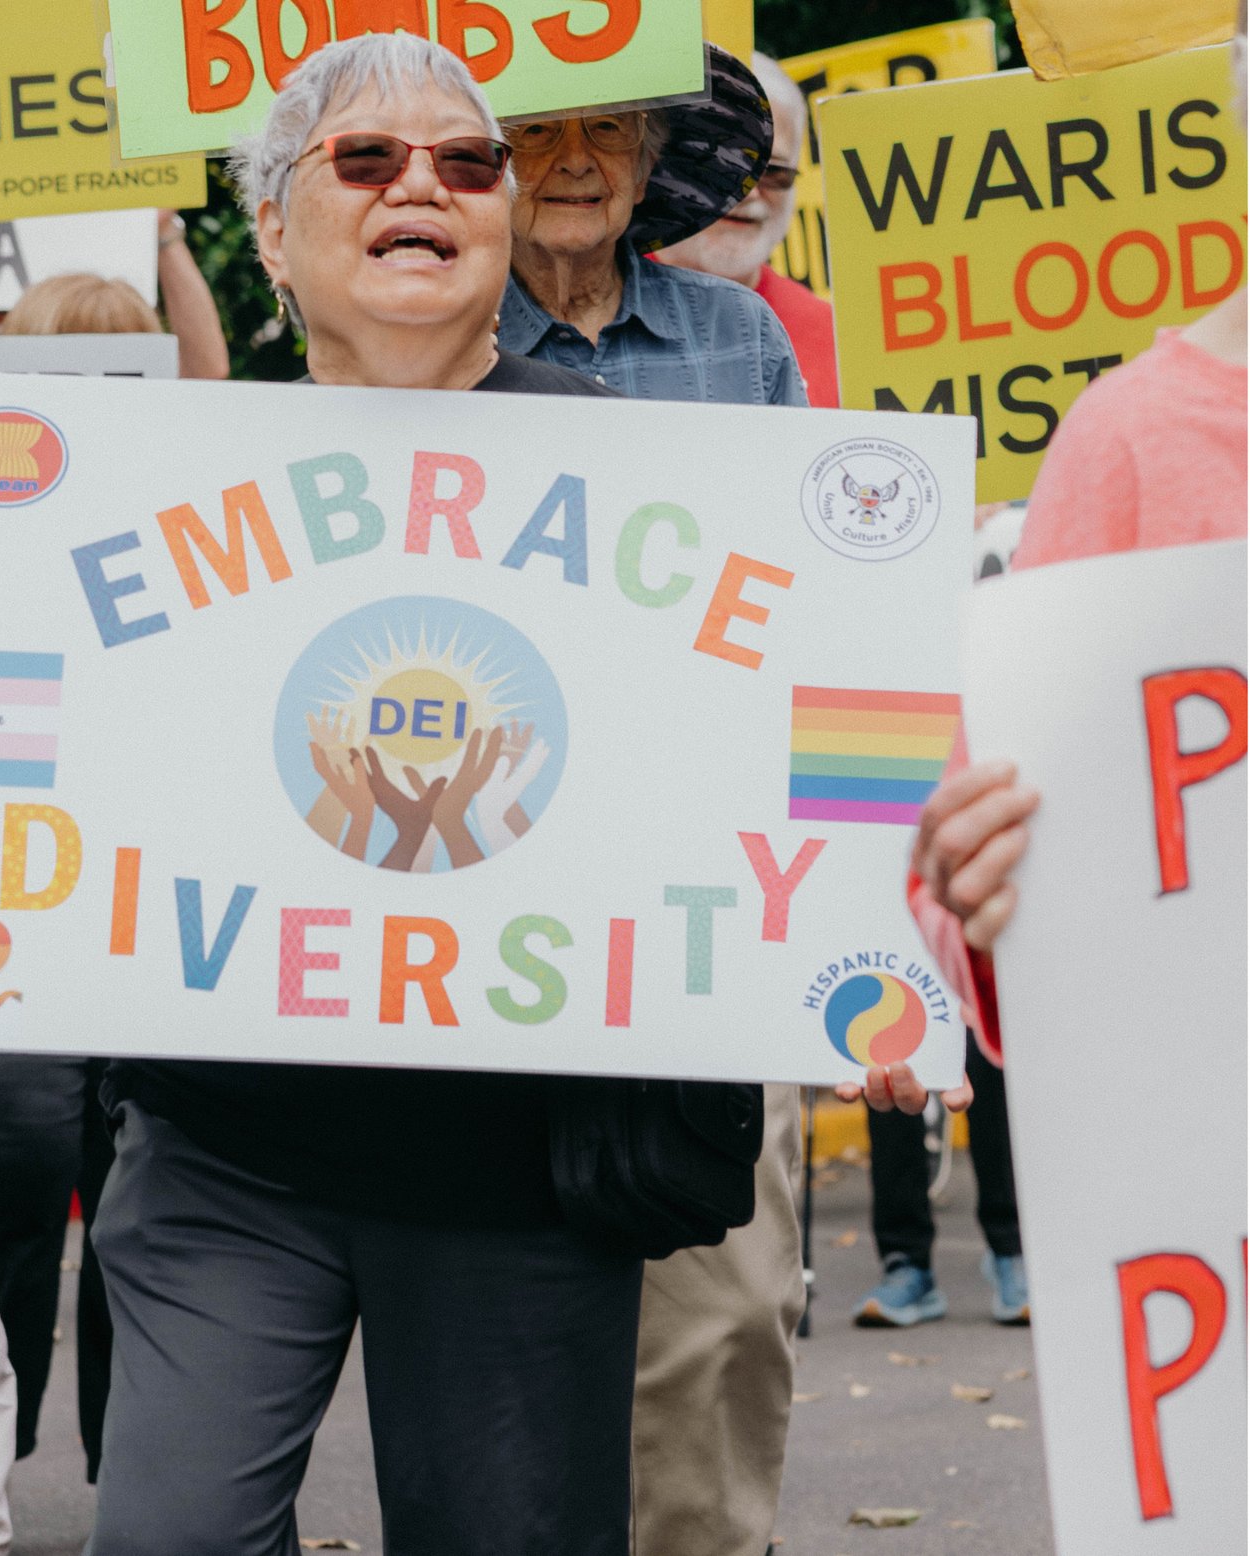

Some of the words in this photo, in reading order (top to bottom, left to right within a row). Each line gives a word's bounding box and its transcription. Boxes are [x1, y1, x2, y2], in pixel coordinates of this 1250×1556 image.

[181, 0, 641, 114] BOB
[75, 166, 179, 191] FRANCIS
[842, 117, 1116, 233] WAR
[1138, 99, 1228, 195] IS
[812, 446, 843, 482] AMERICAN
[844, 442, 875, 452] INDIAN
[877, 443, 912, 463] SOCIETY
[824, 492, 835, 521] Unity
[842, 527, 888, 542] Culture
[894, 497, 916, 534] History
[71, 450, 796, 672] EMBRACE
[368, 696, 467, 740] DEI
[0, 802, 828, 1028] DIVERSITY
[803, 951, 898, 1010] HISPANIC
[905, 962, 950, 1024] UNITY
[1117, 1238, 1247, 1522] P
